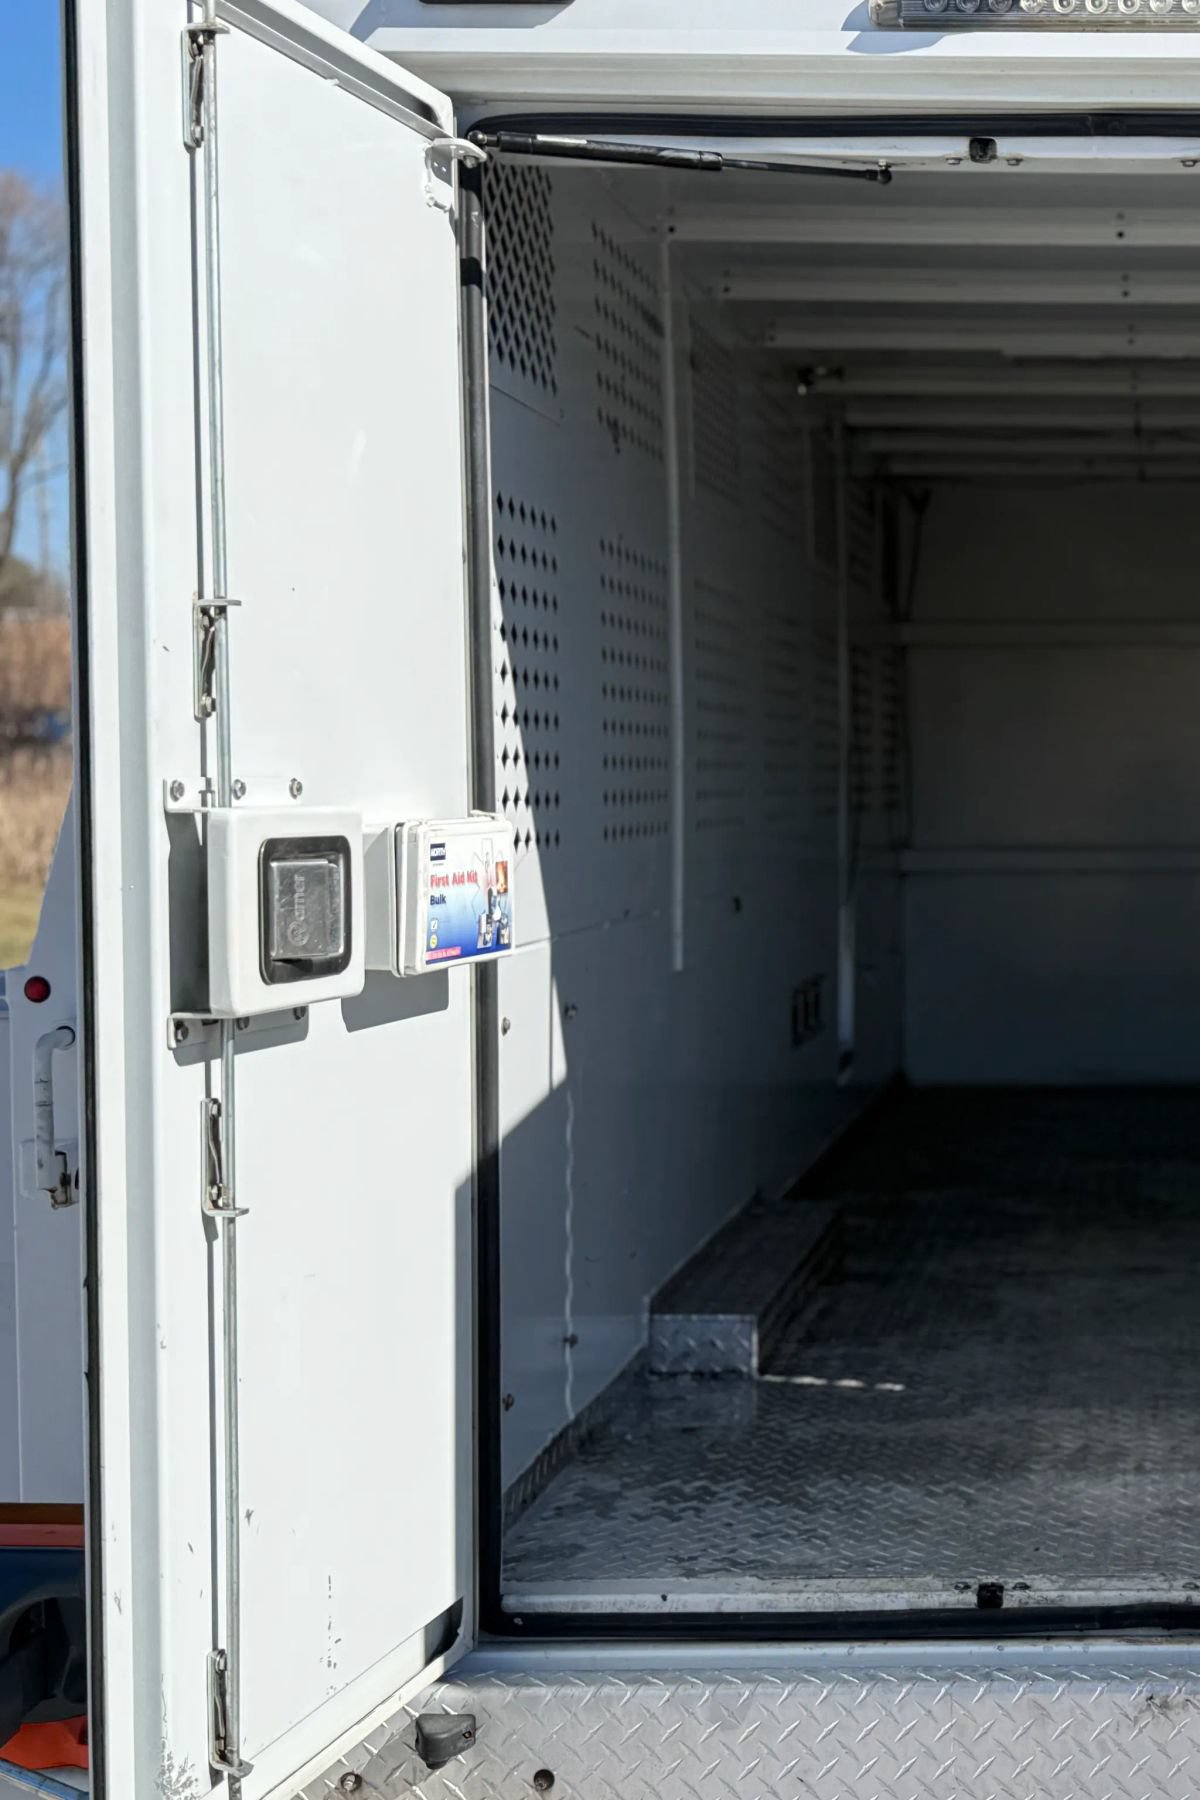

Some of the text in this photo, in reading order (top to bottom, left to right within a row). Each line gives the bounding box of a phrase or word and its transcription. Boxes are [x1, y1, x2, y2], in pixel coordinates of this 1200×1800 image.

[430, 869, 478, 888] First Aid Kit
[430, 894, 447, 906] Bulk
